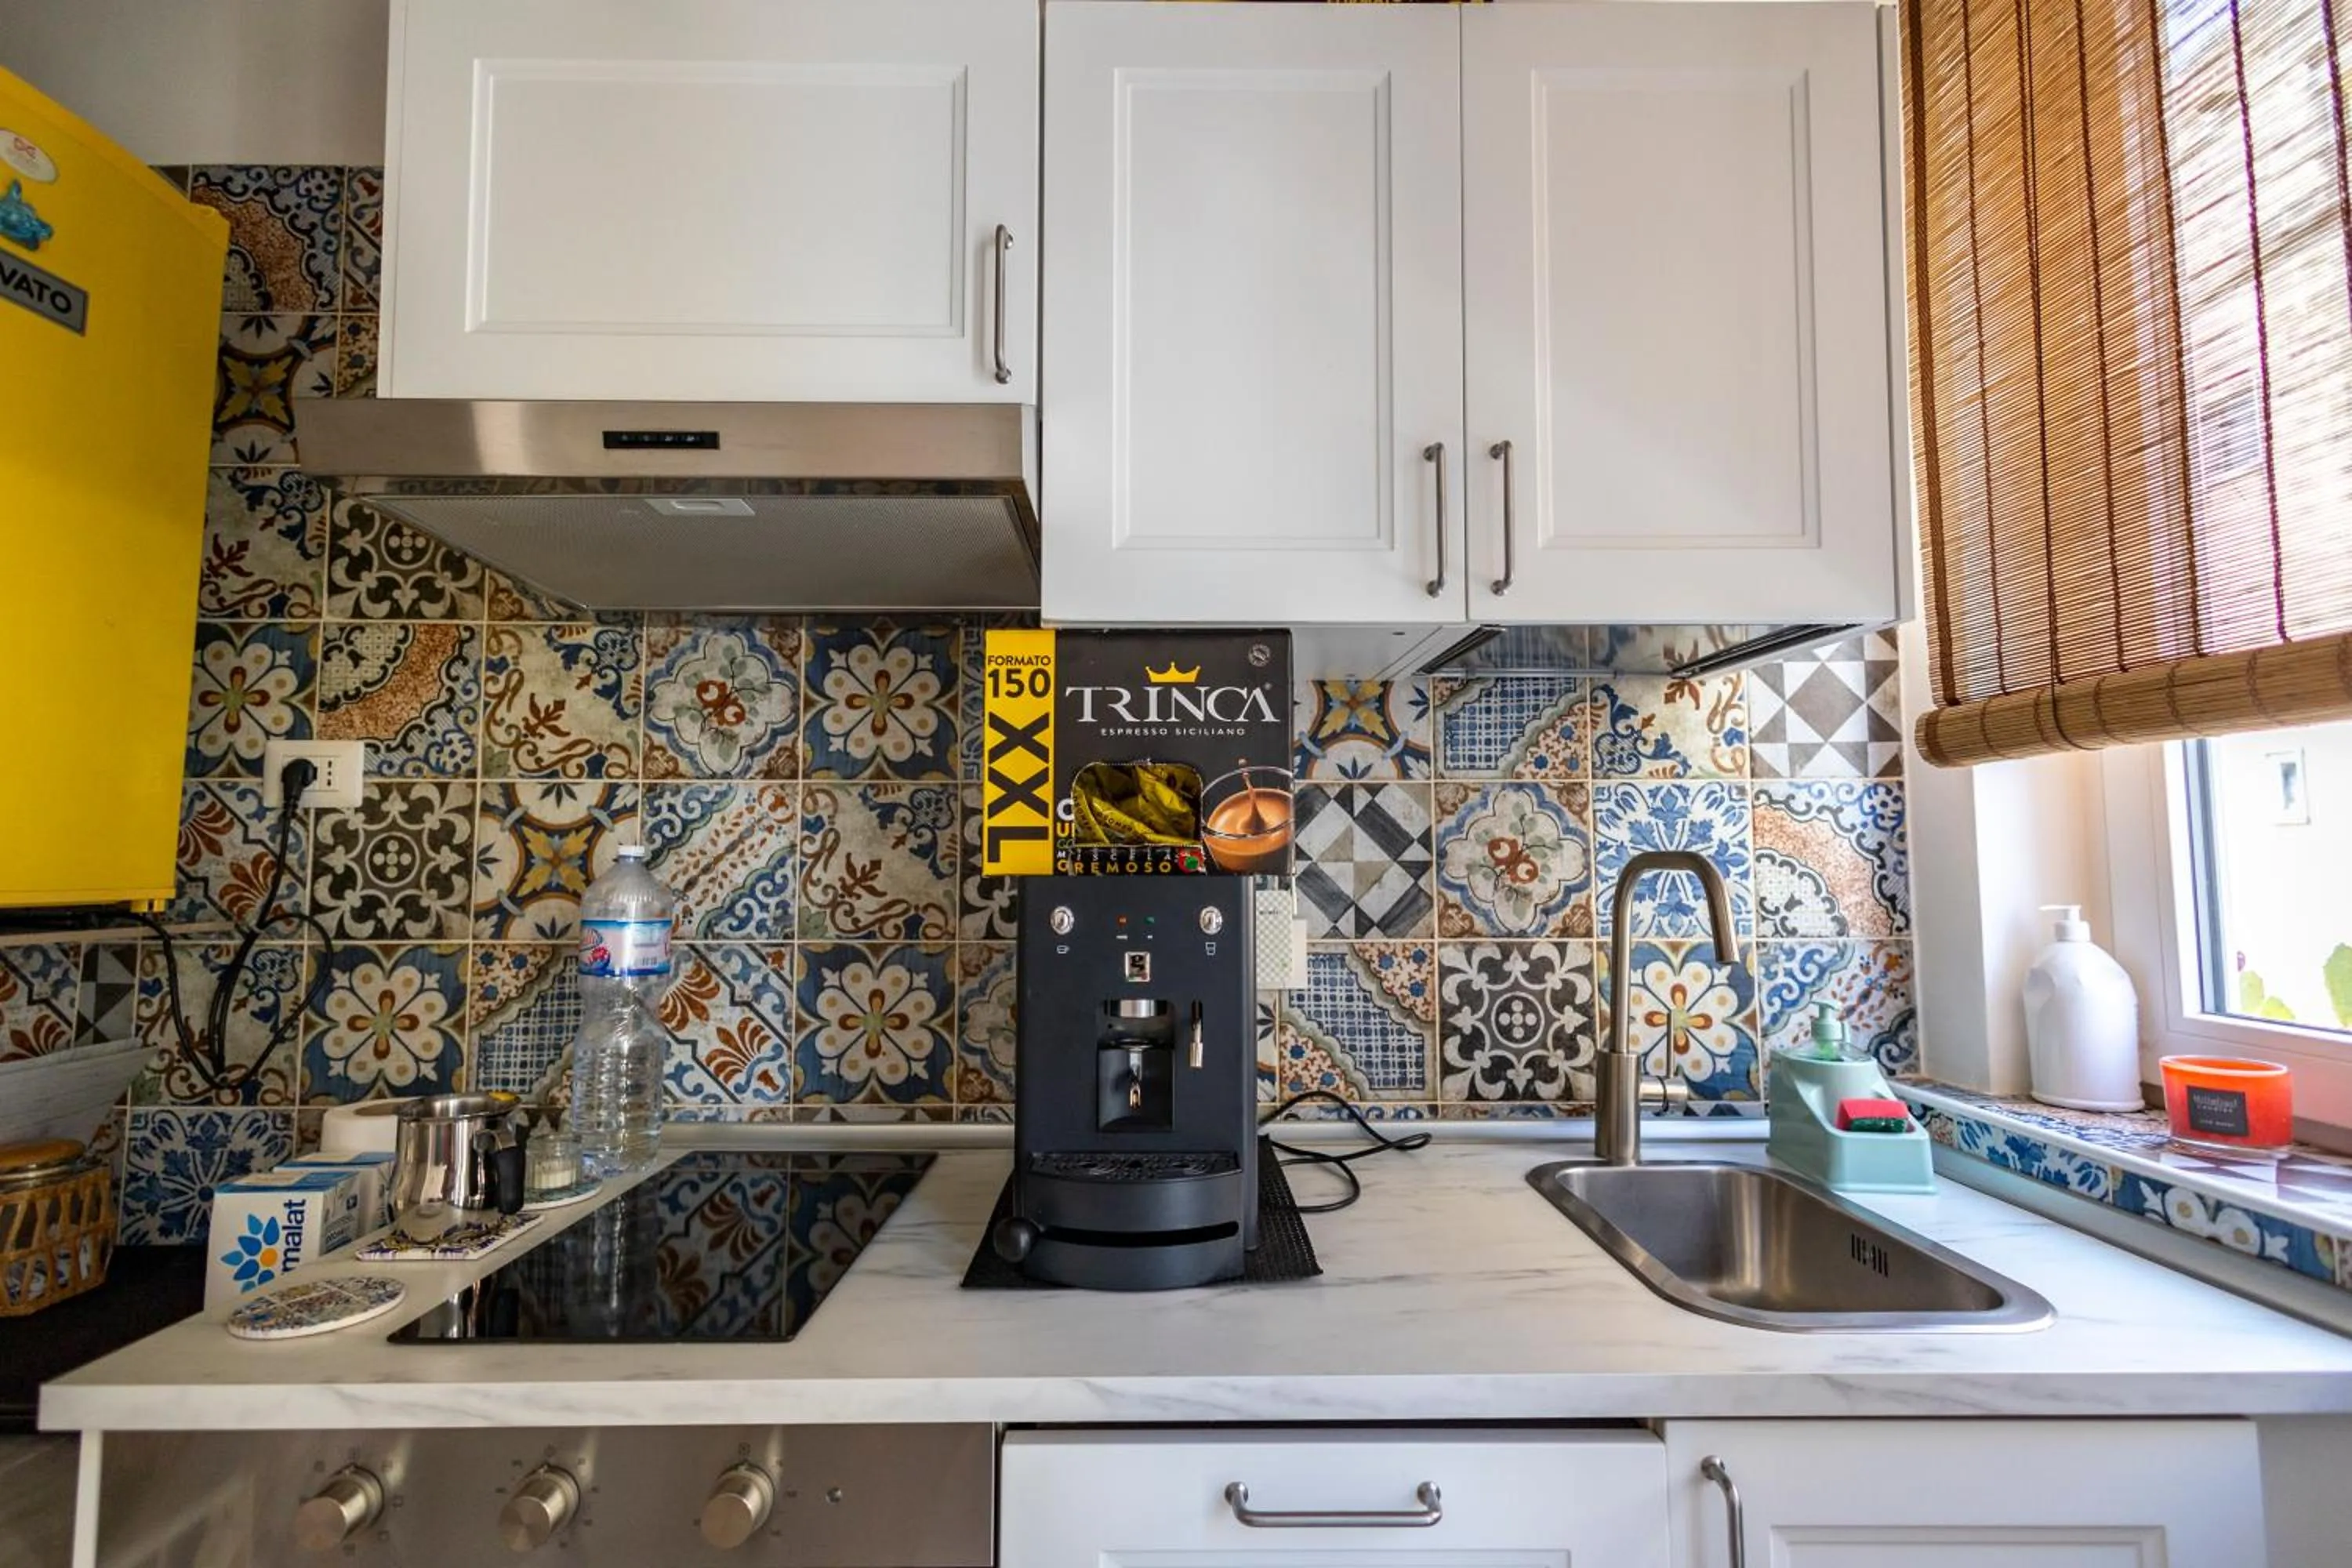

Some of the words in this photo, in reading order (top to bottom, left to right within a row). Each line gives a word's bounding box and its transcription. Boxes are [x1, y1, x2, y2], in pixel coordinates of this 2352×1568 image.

[988, 655, 1051, 666] FORMATO
[988, 669, 1051, 699] 150
[1065, 686, 1279, 722] TRINCA
[1101, 728, 1167, 736] ESPRESSO
[1176, 728, 1246, 736] SICILIANO
[987, 711, 1050, 863] XXL
